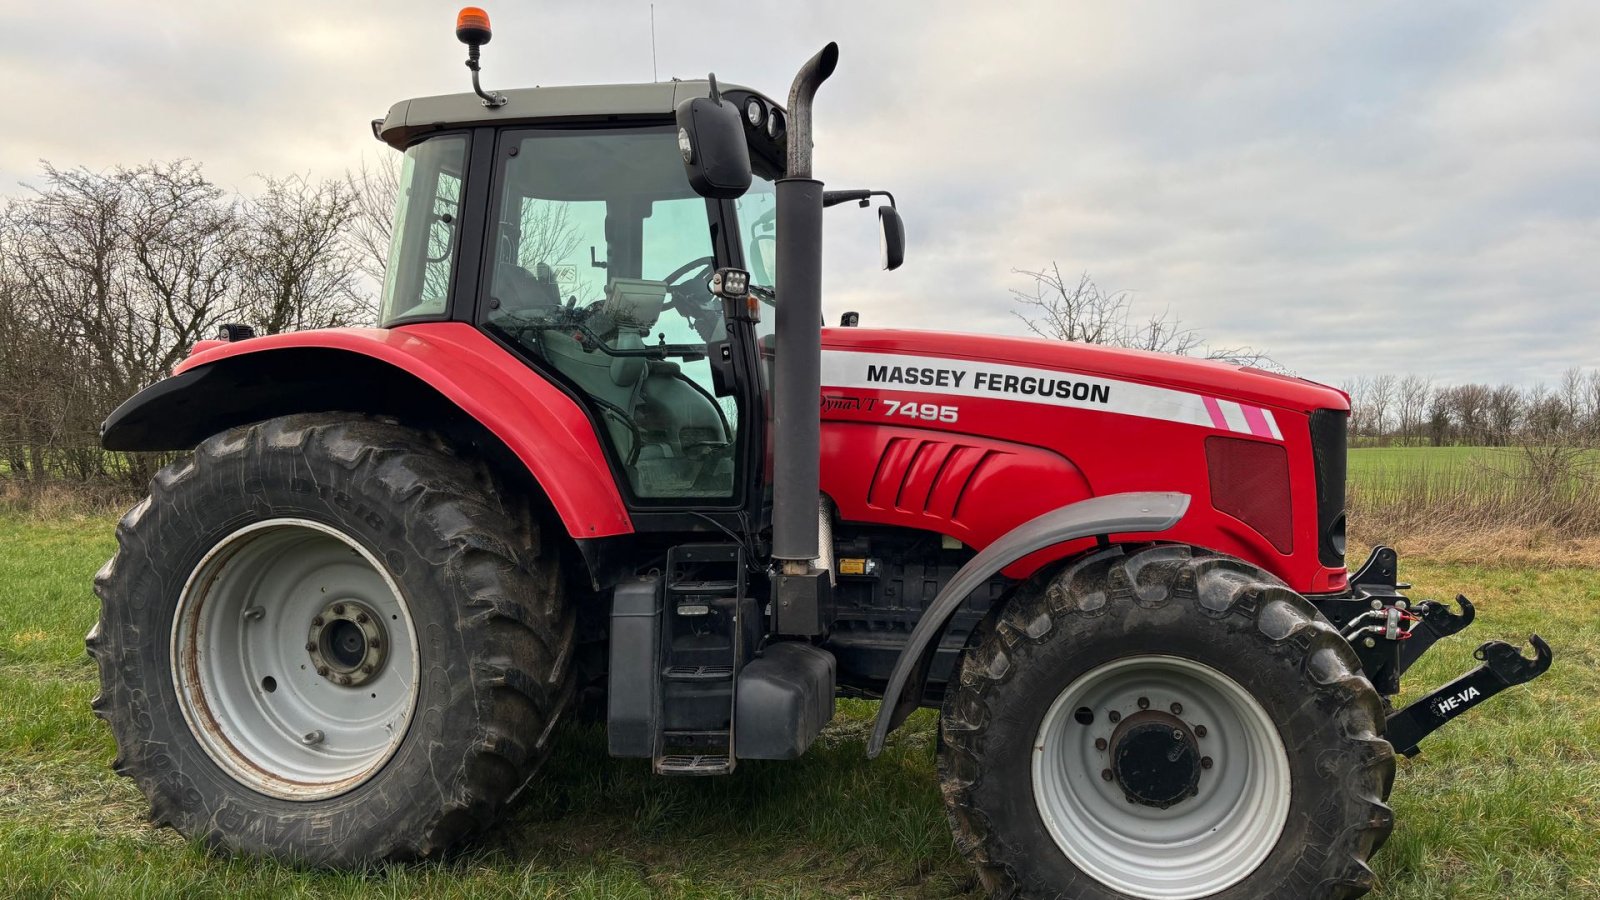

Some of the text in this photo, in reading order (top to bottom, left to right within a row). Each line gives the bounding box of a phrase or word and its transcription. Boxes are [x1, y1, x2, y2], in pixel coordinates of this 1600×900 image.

[867, 365, 1110, 403] MASSEY FERGUSON
[883, 400, 959, 423] 7495
[1438, 686, 1481, 714] HE-VA
